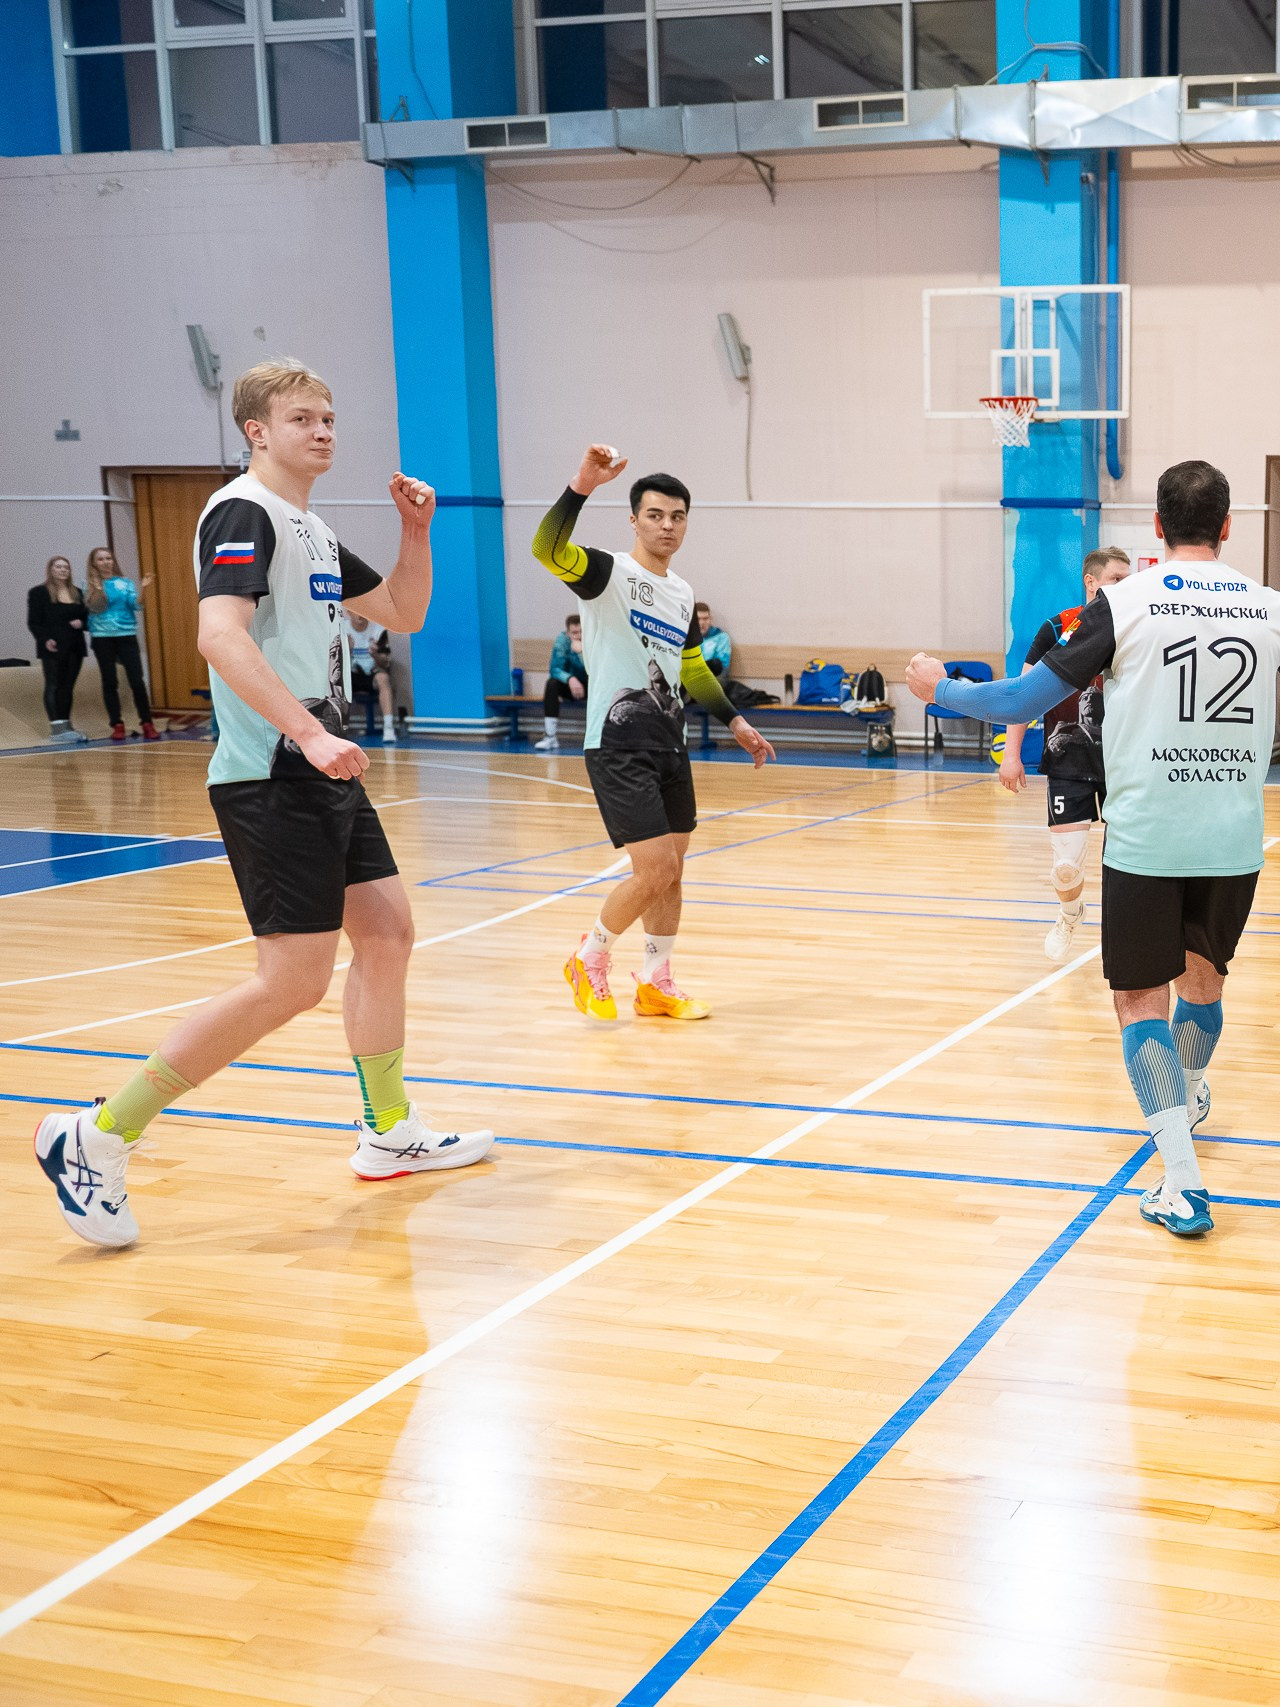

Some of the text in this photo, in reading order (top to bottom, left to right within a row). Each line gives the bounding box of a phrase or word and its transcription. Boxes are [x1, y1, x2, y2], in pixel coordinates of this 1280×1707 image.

[627, 577, 654, 607] 18
[1185, 579, 1248, 592] VOLLEYDZR
[1149, 603, 1268, 621] ДЗЕРЖИНСКИЙ
[1163, 635, 1257, 725] 12
[1167, 767, 1247, 783] ОБЛАСТЬ
[1053, 795, 1065, 815] 5
